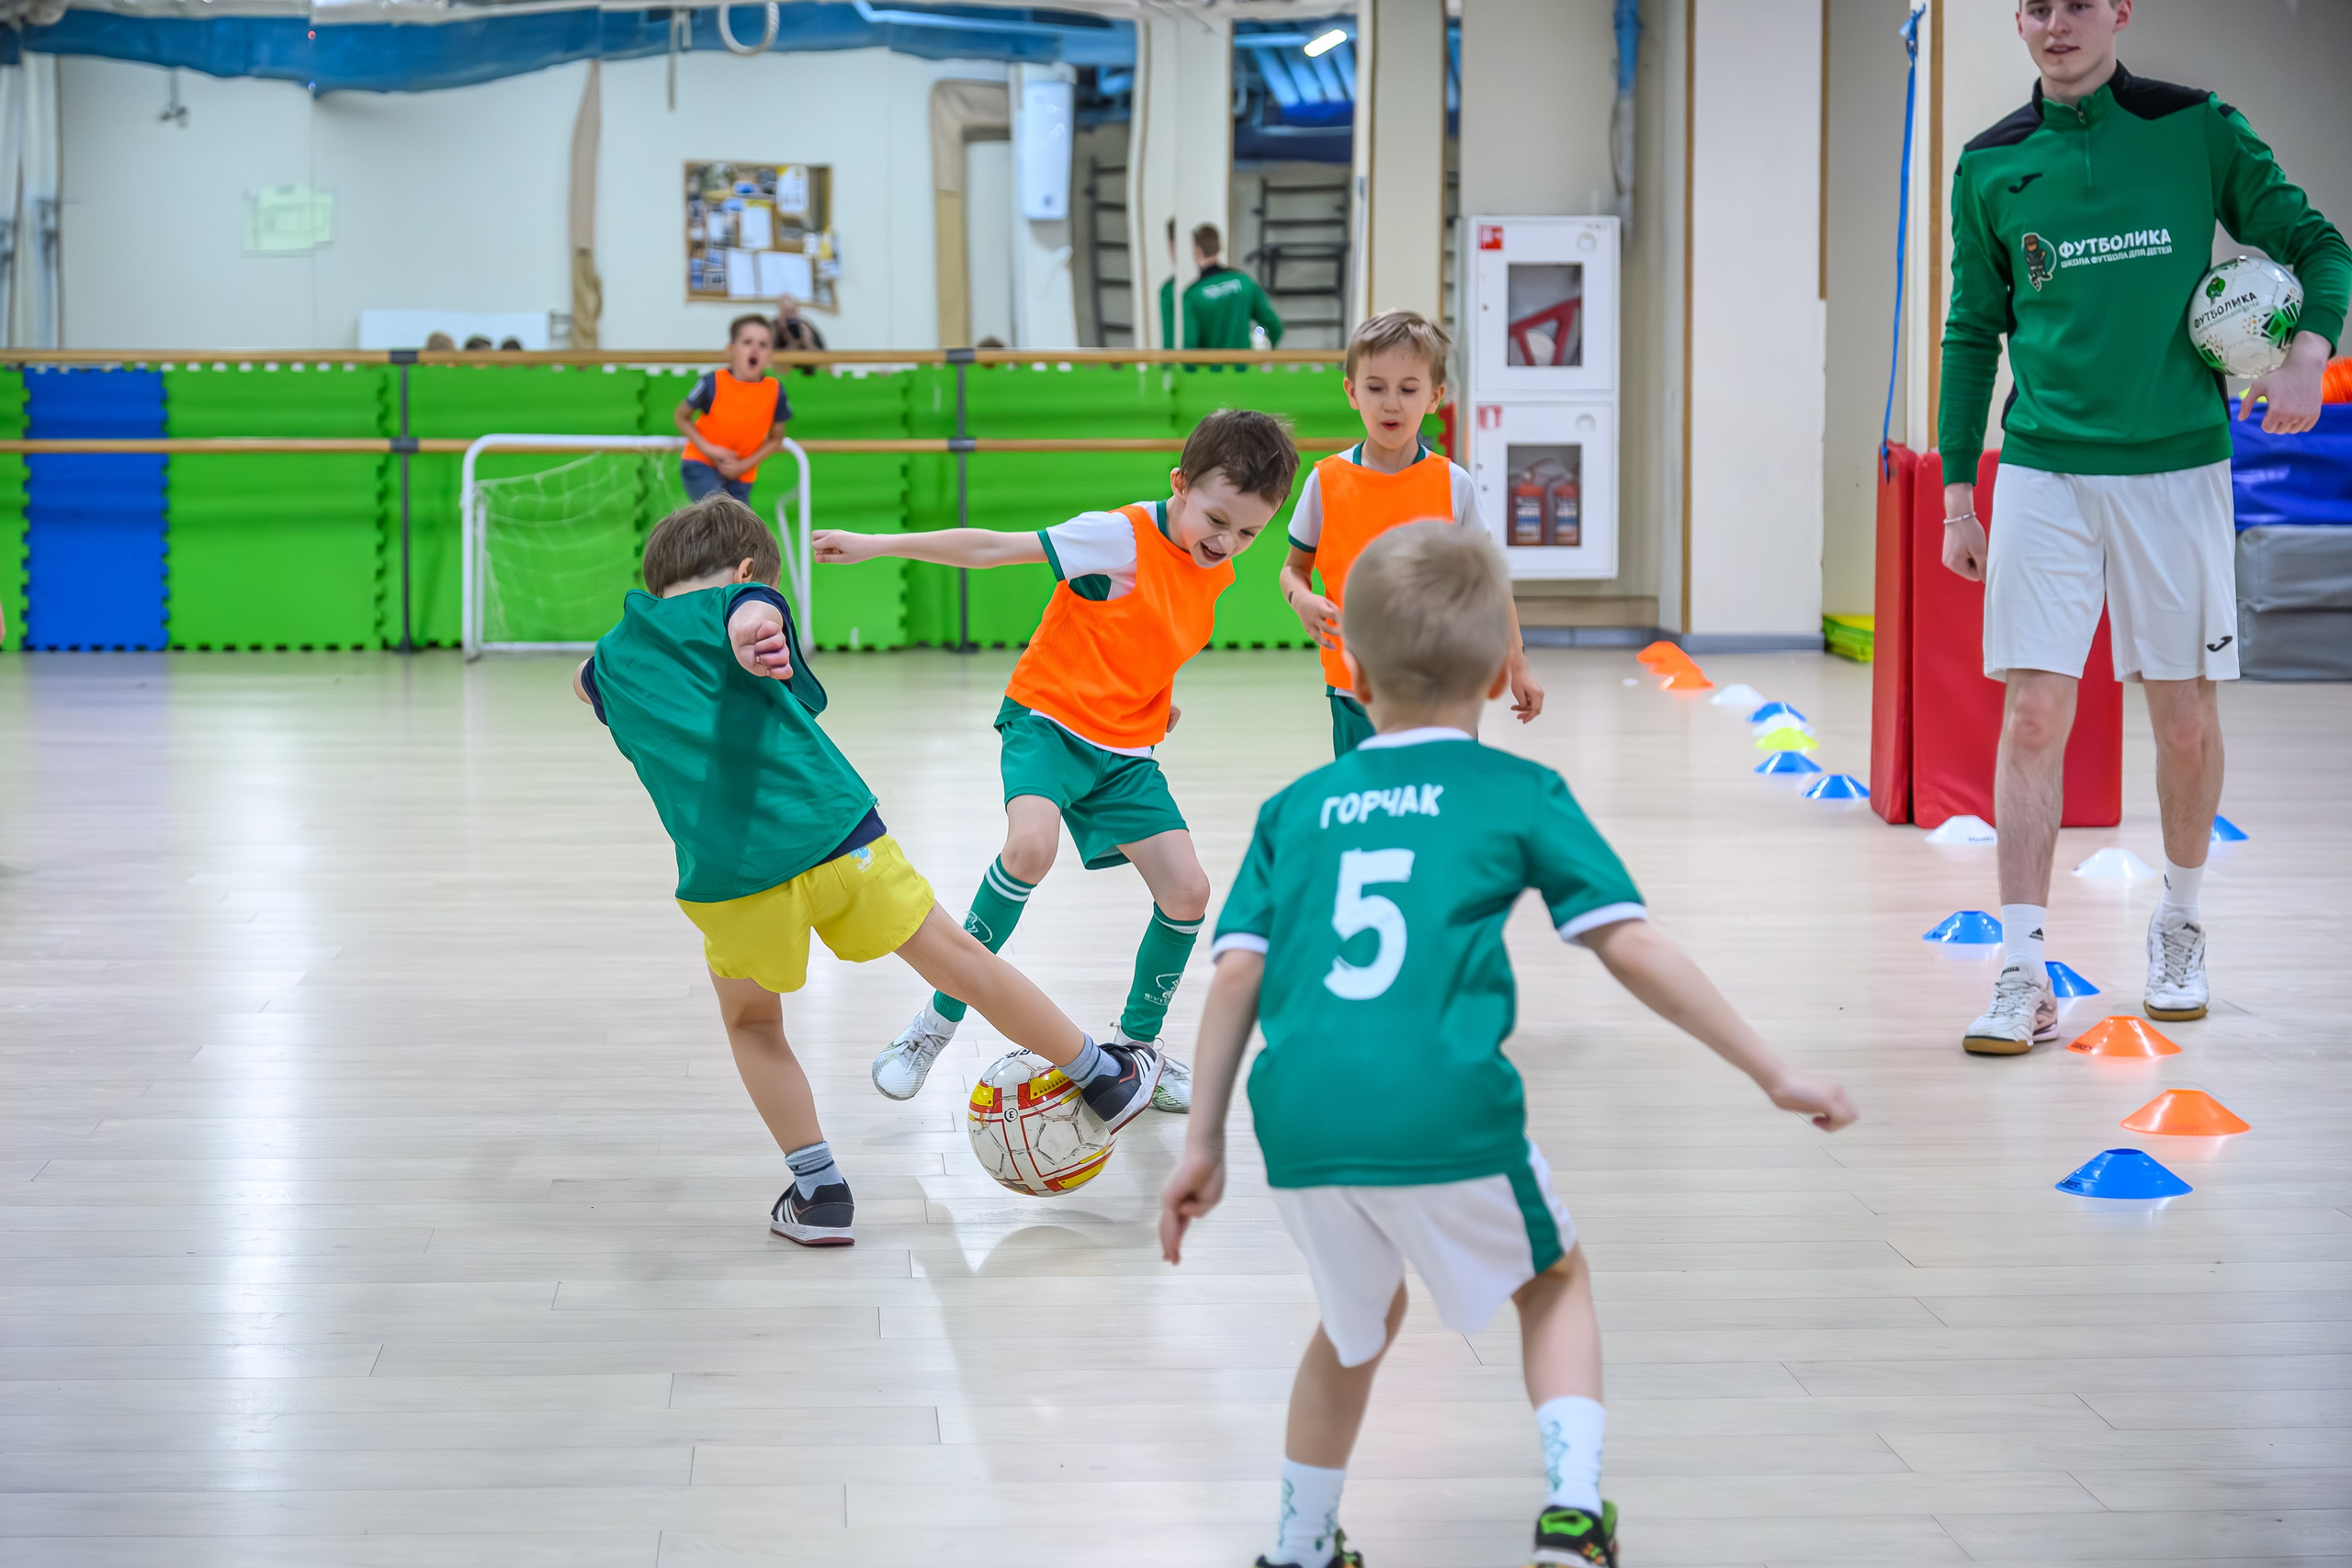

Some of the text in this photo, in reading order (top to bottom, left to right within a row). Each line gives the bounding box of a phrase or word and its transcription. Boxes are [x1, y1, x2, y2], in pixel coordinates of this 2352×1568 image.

[2058, 228, 2172, 258] ФУТБОЛИКА
[2061, 256, 2091, 268] ШКОЛА
[2091, 252, 2129, 264] ФУТБОЛА
[2194, 292, 2257, 329] ФУТБОЛИКА
[1319, 783, 1444, 829] ГОРЧАК
[1323, 847, 1416, 1001] 5
